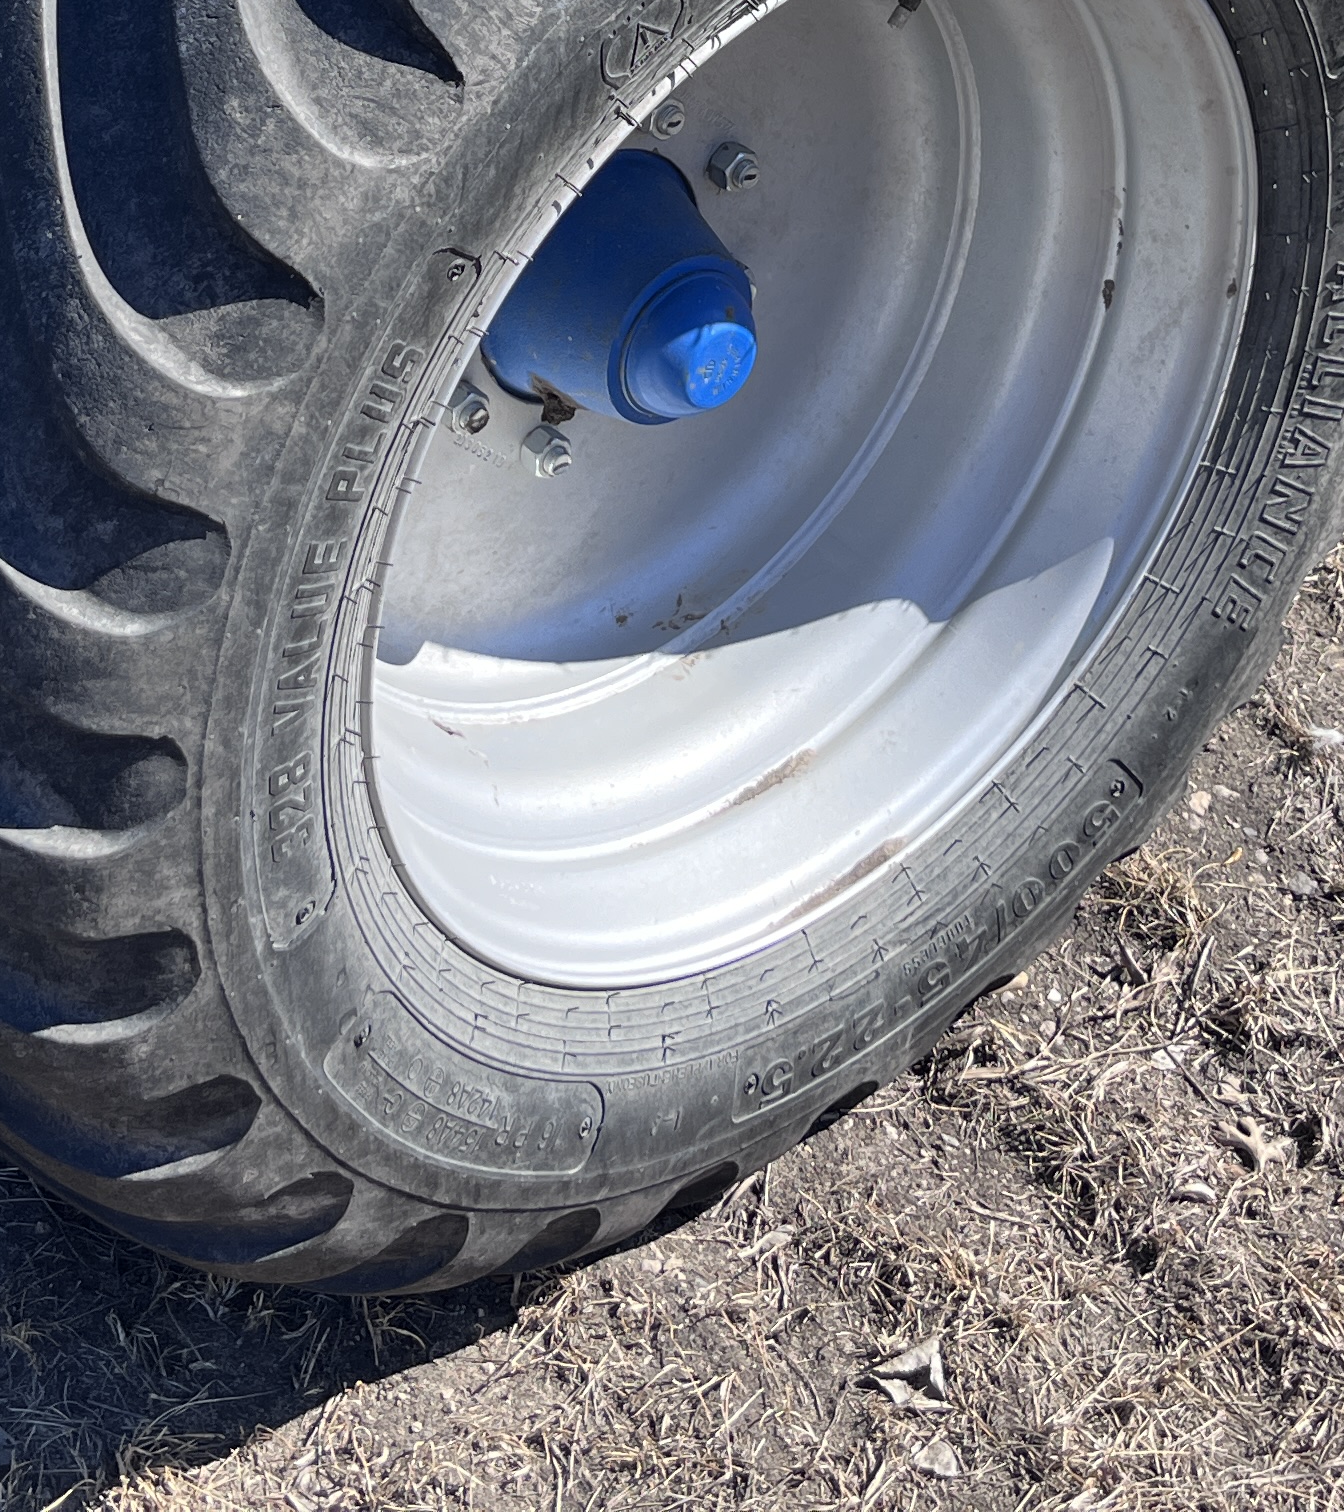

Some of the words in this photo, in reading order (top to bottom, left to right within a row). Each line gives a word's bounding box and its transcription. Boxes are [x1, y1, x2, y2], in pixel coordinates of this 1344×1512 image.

[325, 340, 426, 502] PLUS
[270, 538, 348, 737] VALUE
[268, 750, 317, 864] 328
[903, 913, 974, 977] TUBELESS
[445, 1080, 503, 1122] 142A8
[494, 1115, 534, 1149] PR
[426, 1113, 487, 1155] 154A8
